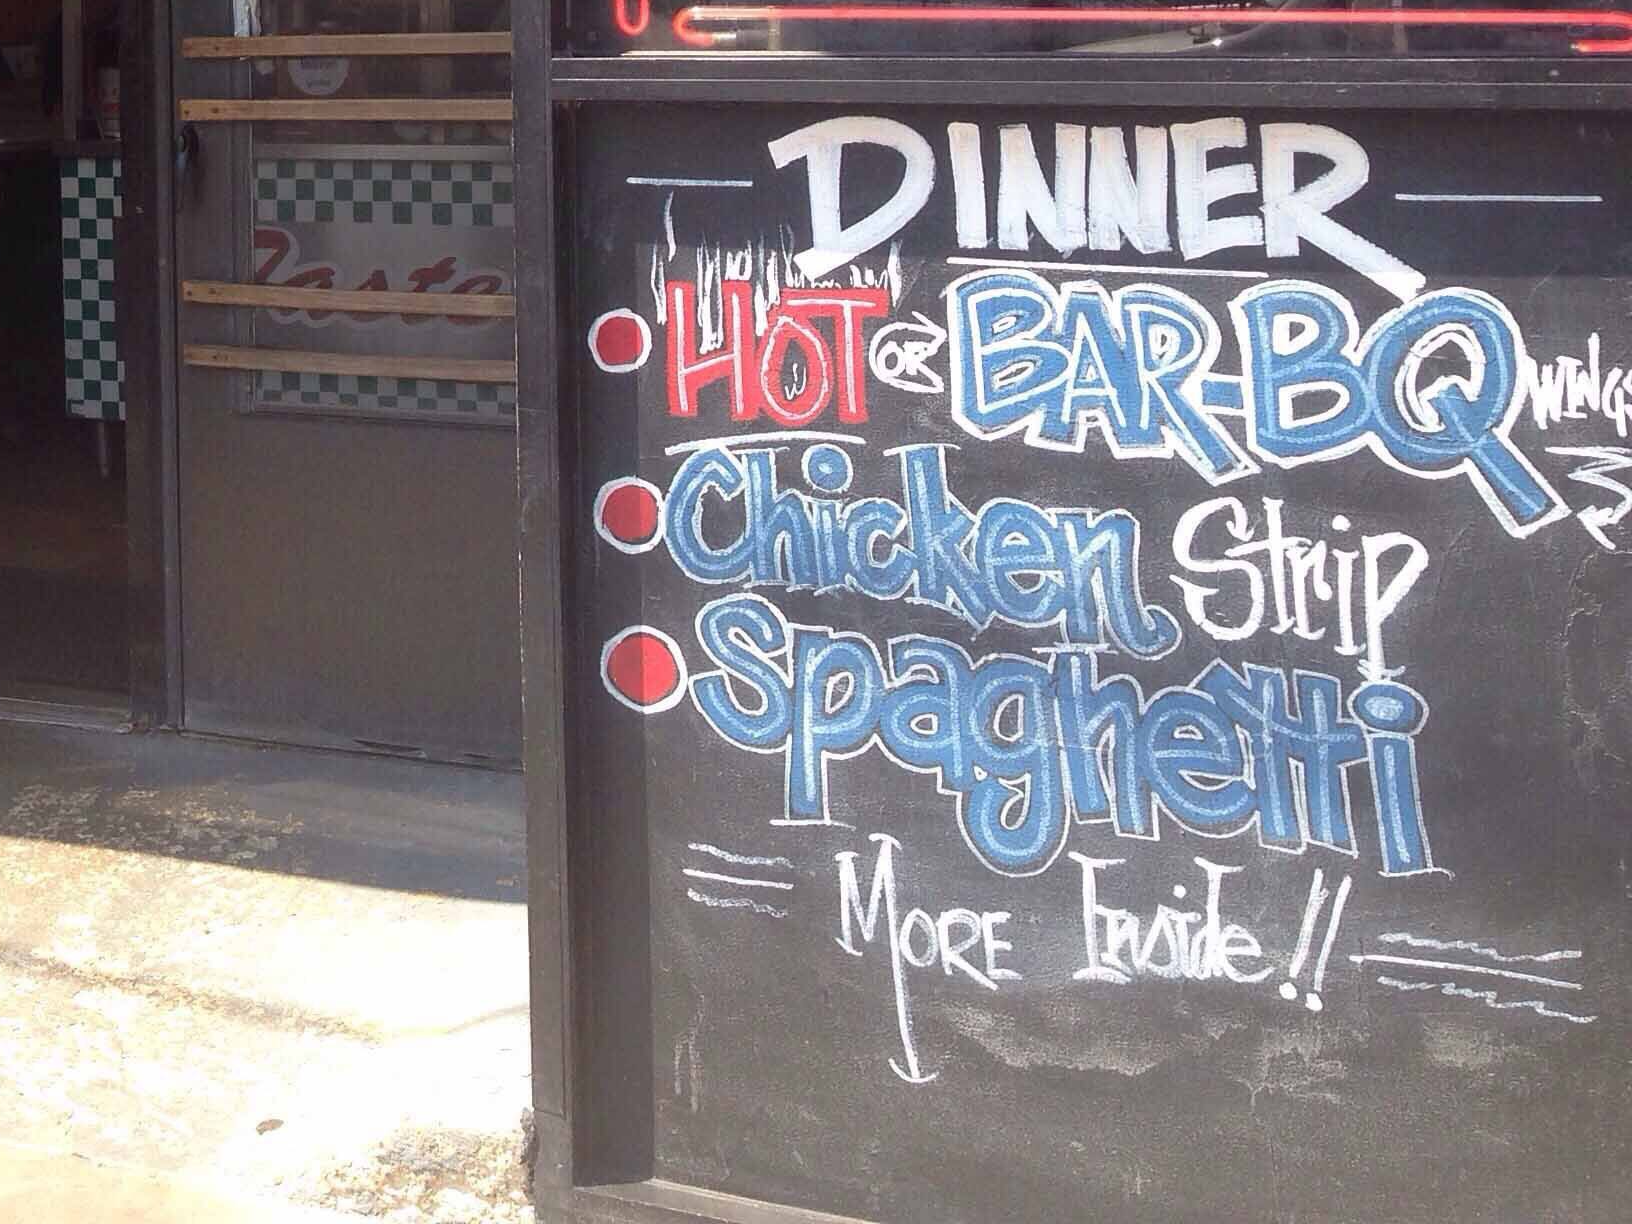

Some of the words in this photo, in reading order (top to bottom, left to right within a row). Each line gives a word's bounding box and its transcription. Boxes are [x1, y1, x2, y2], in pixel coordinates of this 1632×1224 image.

[768, 114, 1426, 298] DINNER
[667, 279, 891, 427] HOT
[946, 268, 1572, 538] BAR-BQ
[662, 444, 1182, 660] Chicken
[1168, 496, 1430, 681] Strip
[688, 594, 1454, 878] Spaghetti
[833, 834, 1016, 1083] MORE
